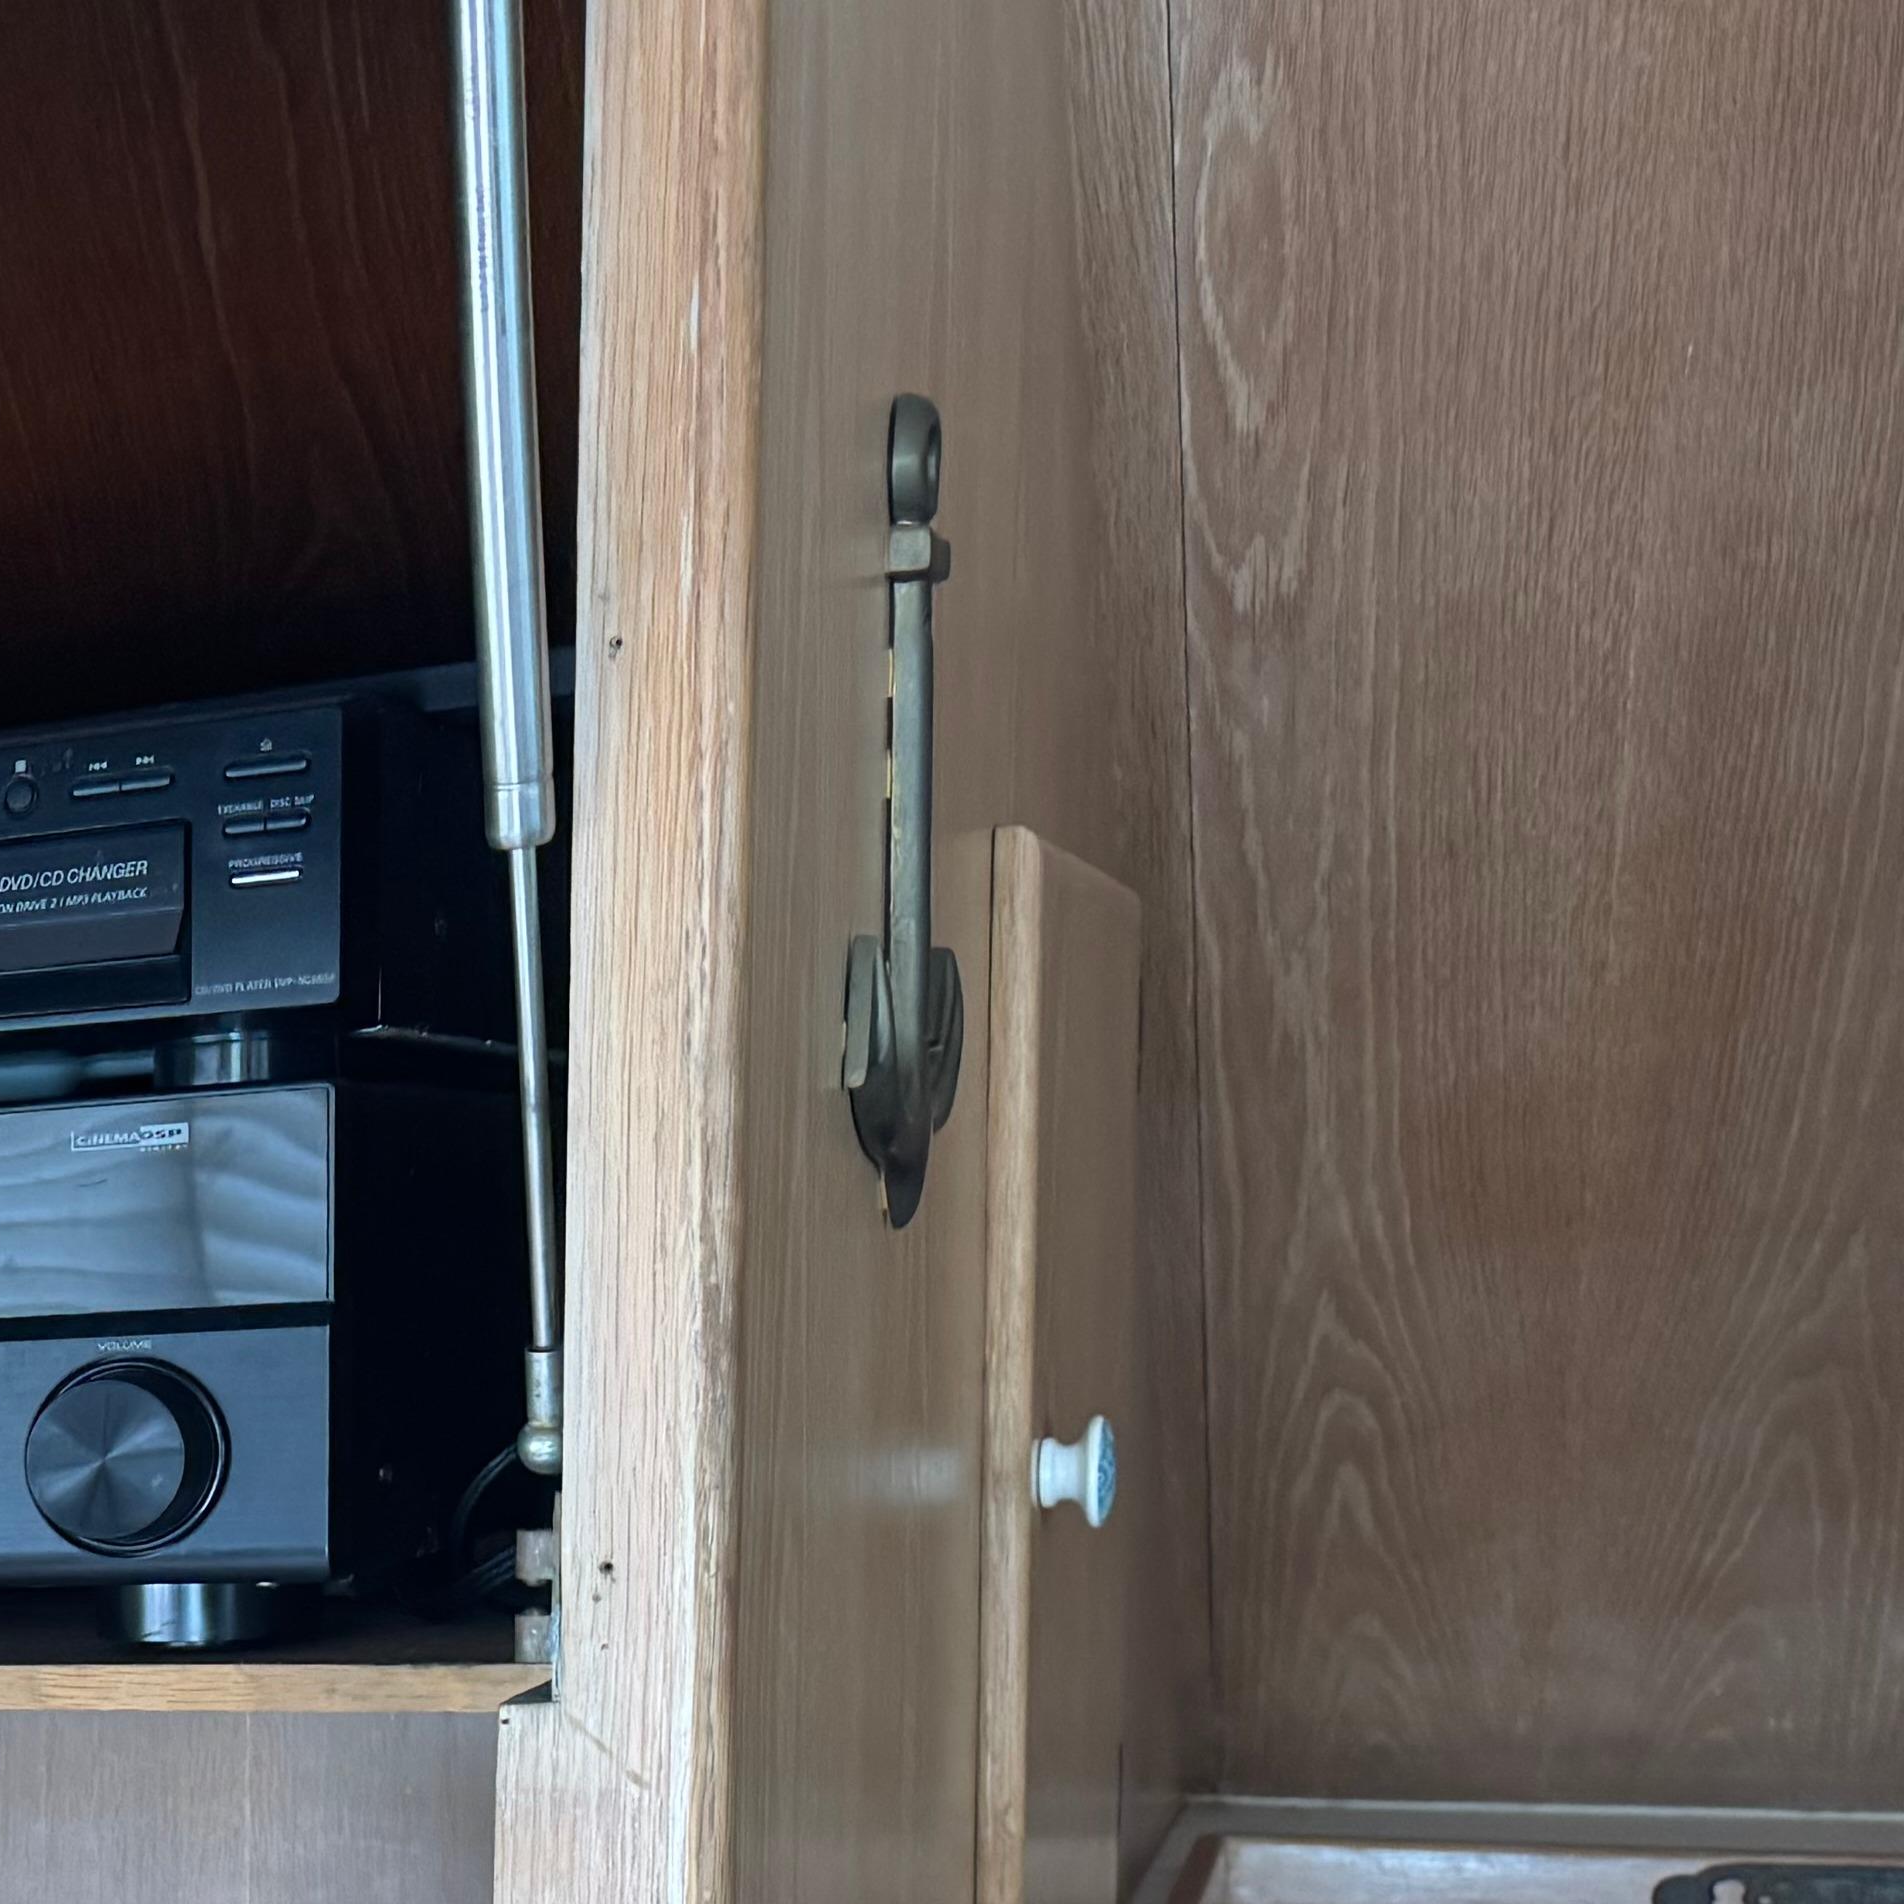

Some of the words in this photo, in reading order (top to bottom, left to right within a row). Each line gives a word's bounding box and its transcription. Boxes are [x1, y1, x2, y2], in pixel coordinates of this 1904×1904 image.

[67, 860, 149, 884] CHANGER
[16, 899, 47, 912] DRIVE
[91, 886, 149, 904] PLAYBACK
